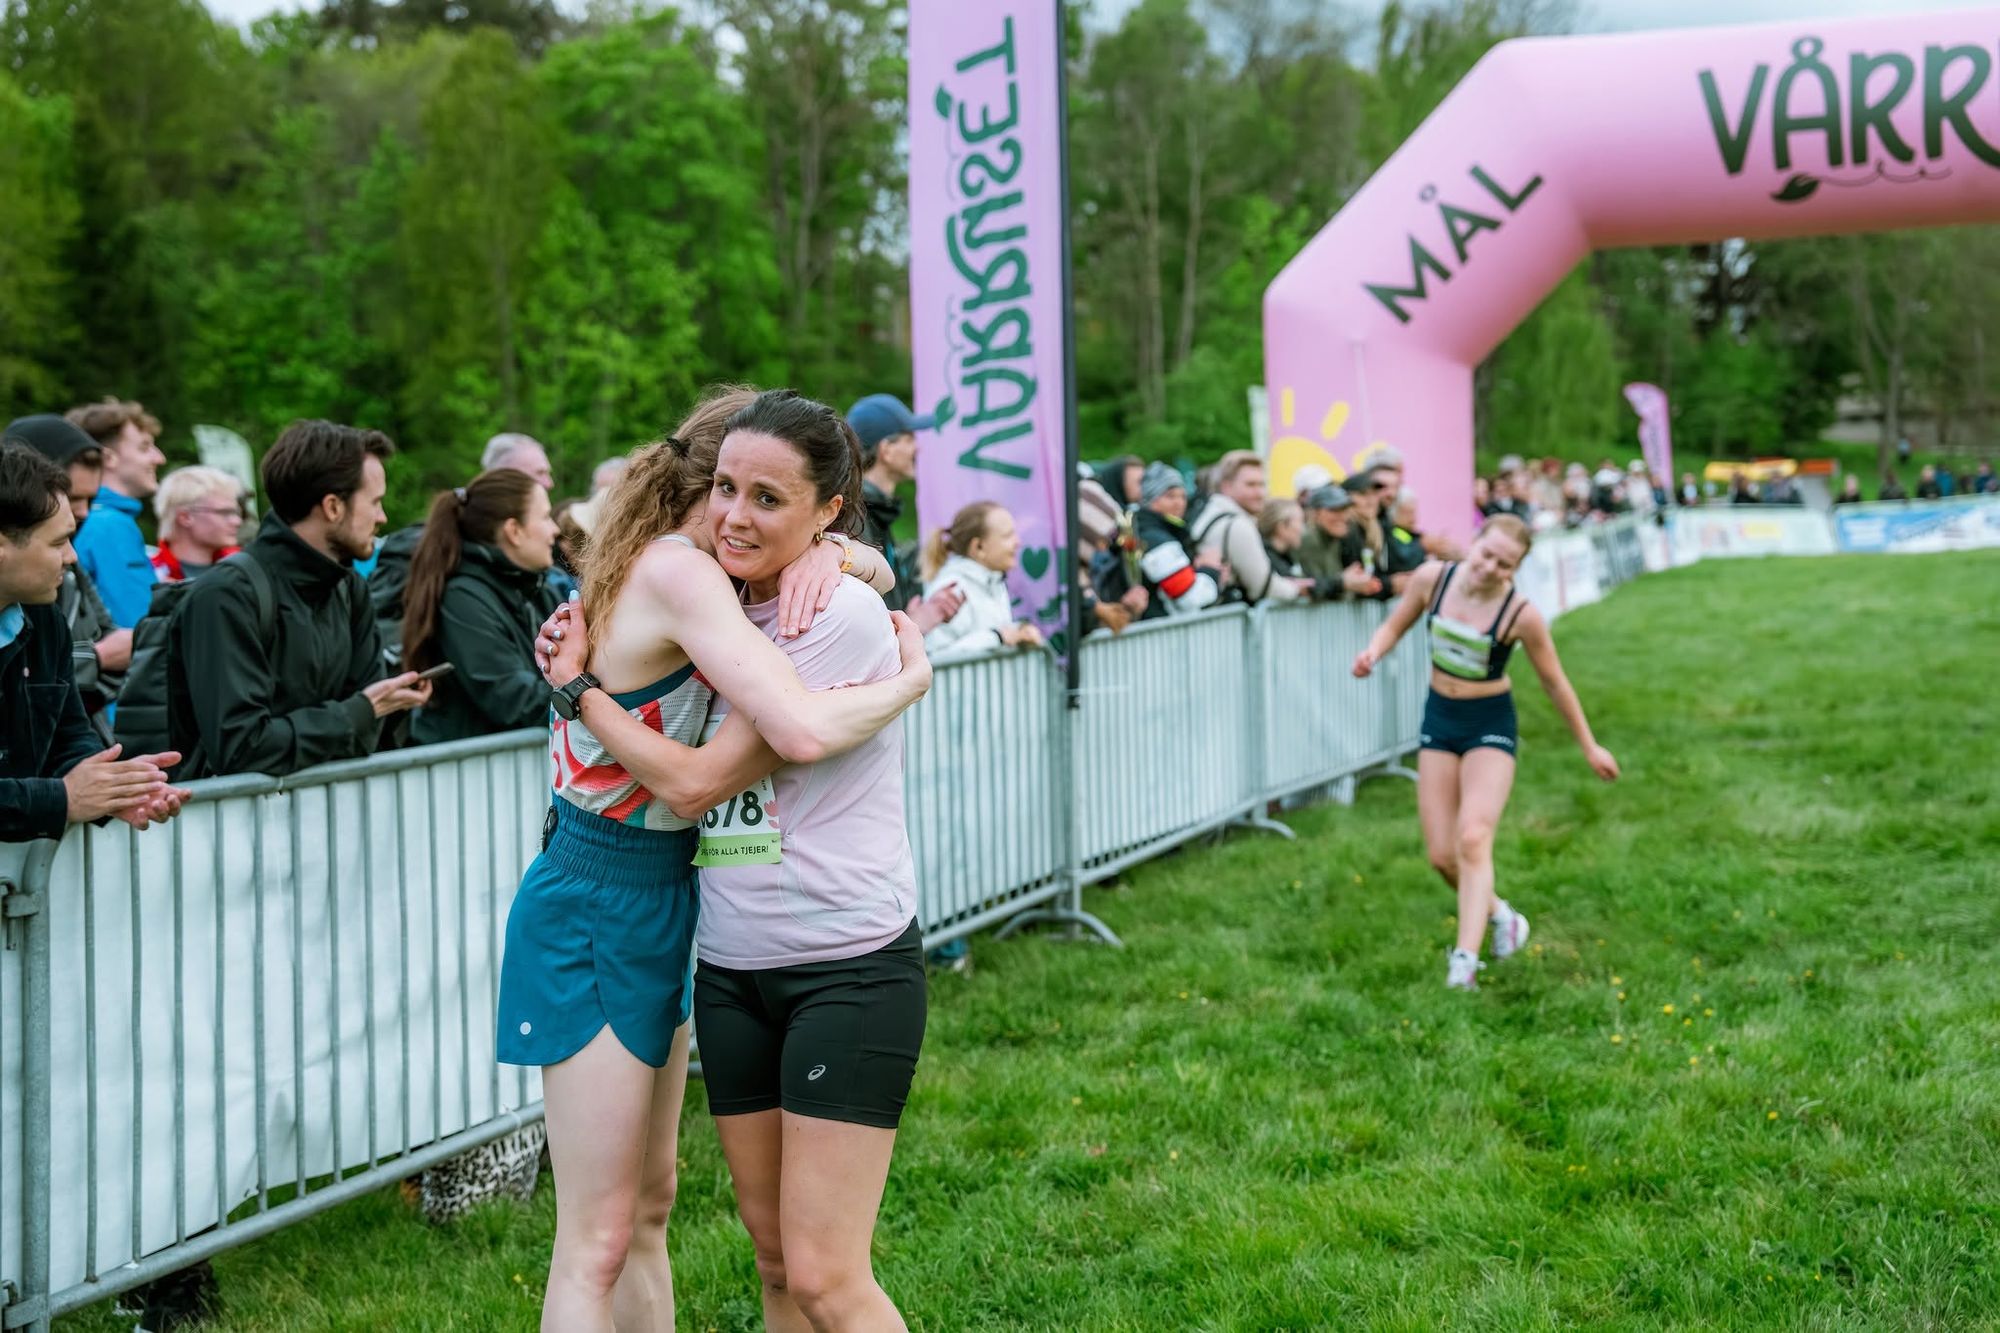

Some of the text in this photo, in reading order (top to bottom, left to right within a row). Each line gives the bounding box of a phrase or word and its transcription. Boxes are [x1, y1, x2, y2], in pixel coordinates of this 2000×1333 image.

[1698, 36, 2000, 175] VÅRR
[1363, 165, 1544, 324] MÅL
[720, 846, 739, 856] ALLA
[740, 845, 769, 856] TJEJER!
